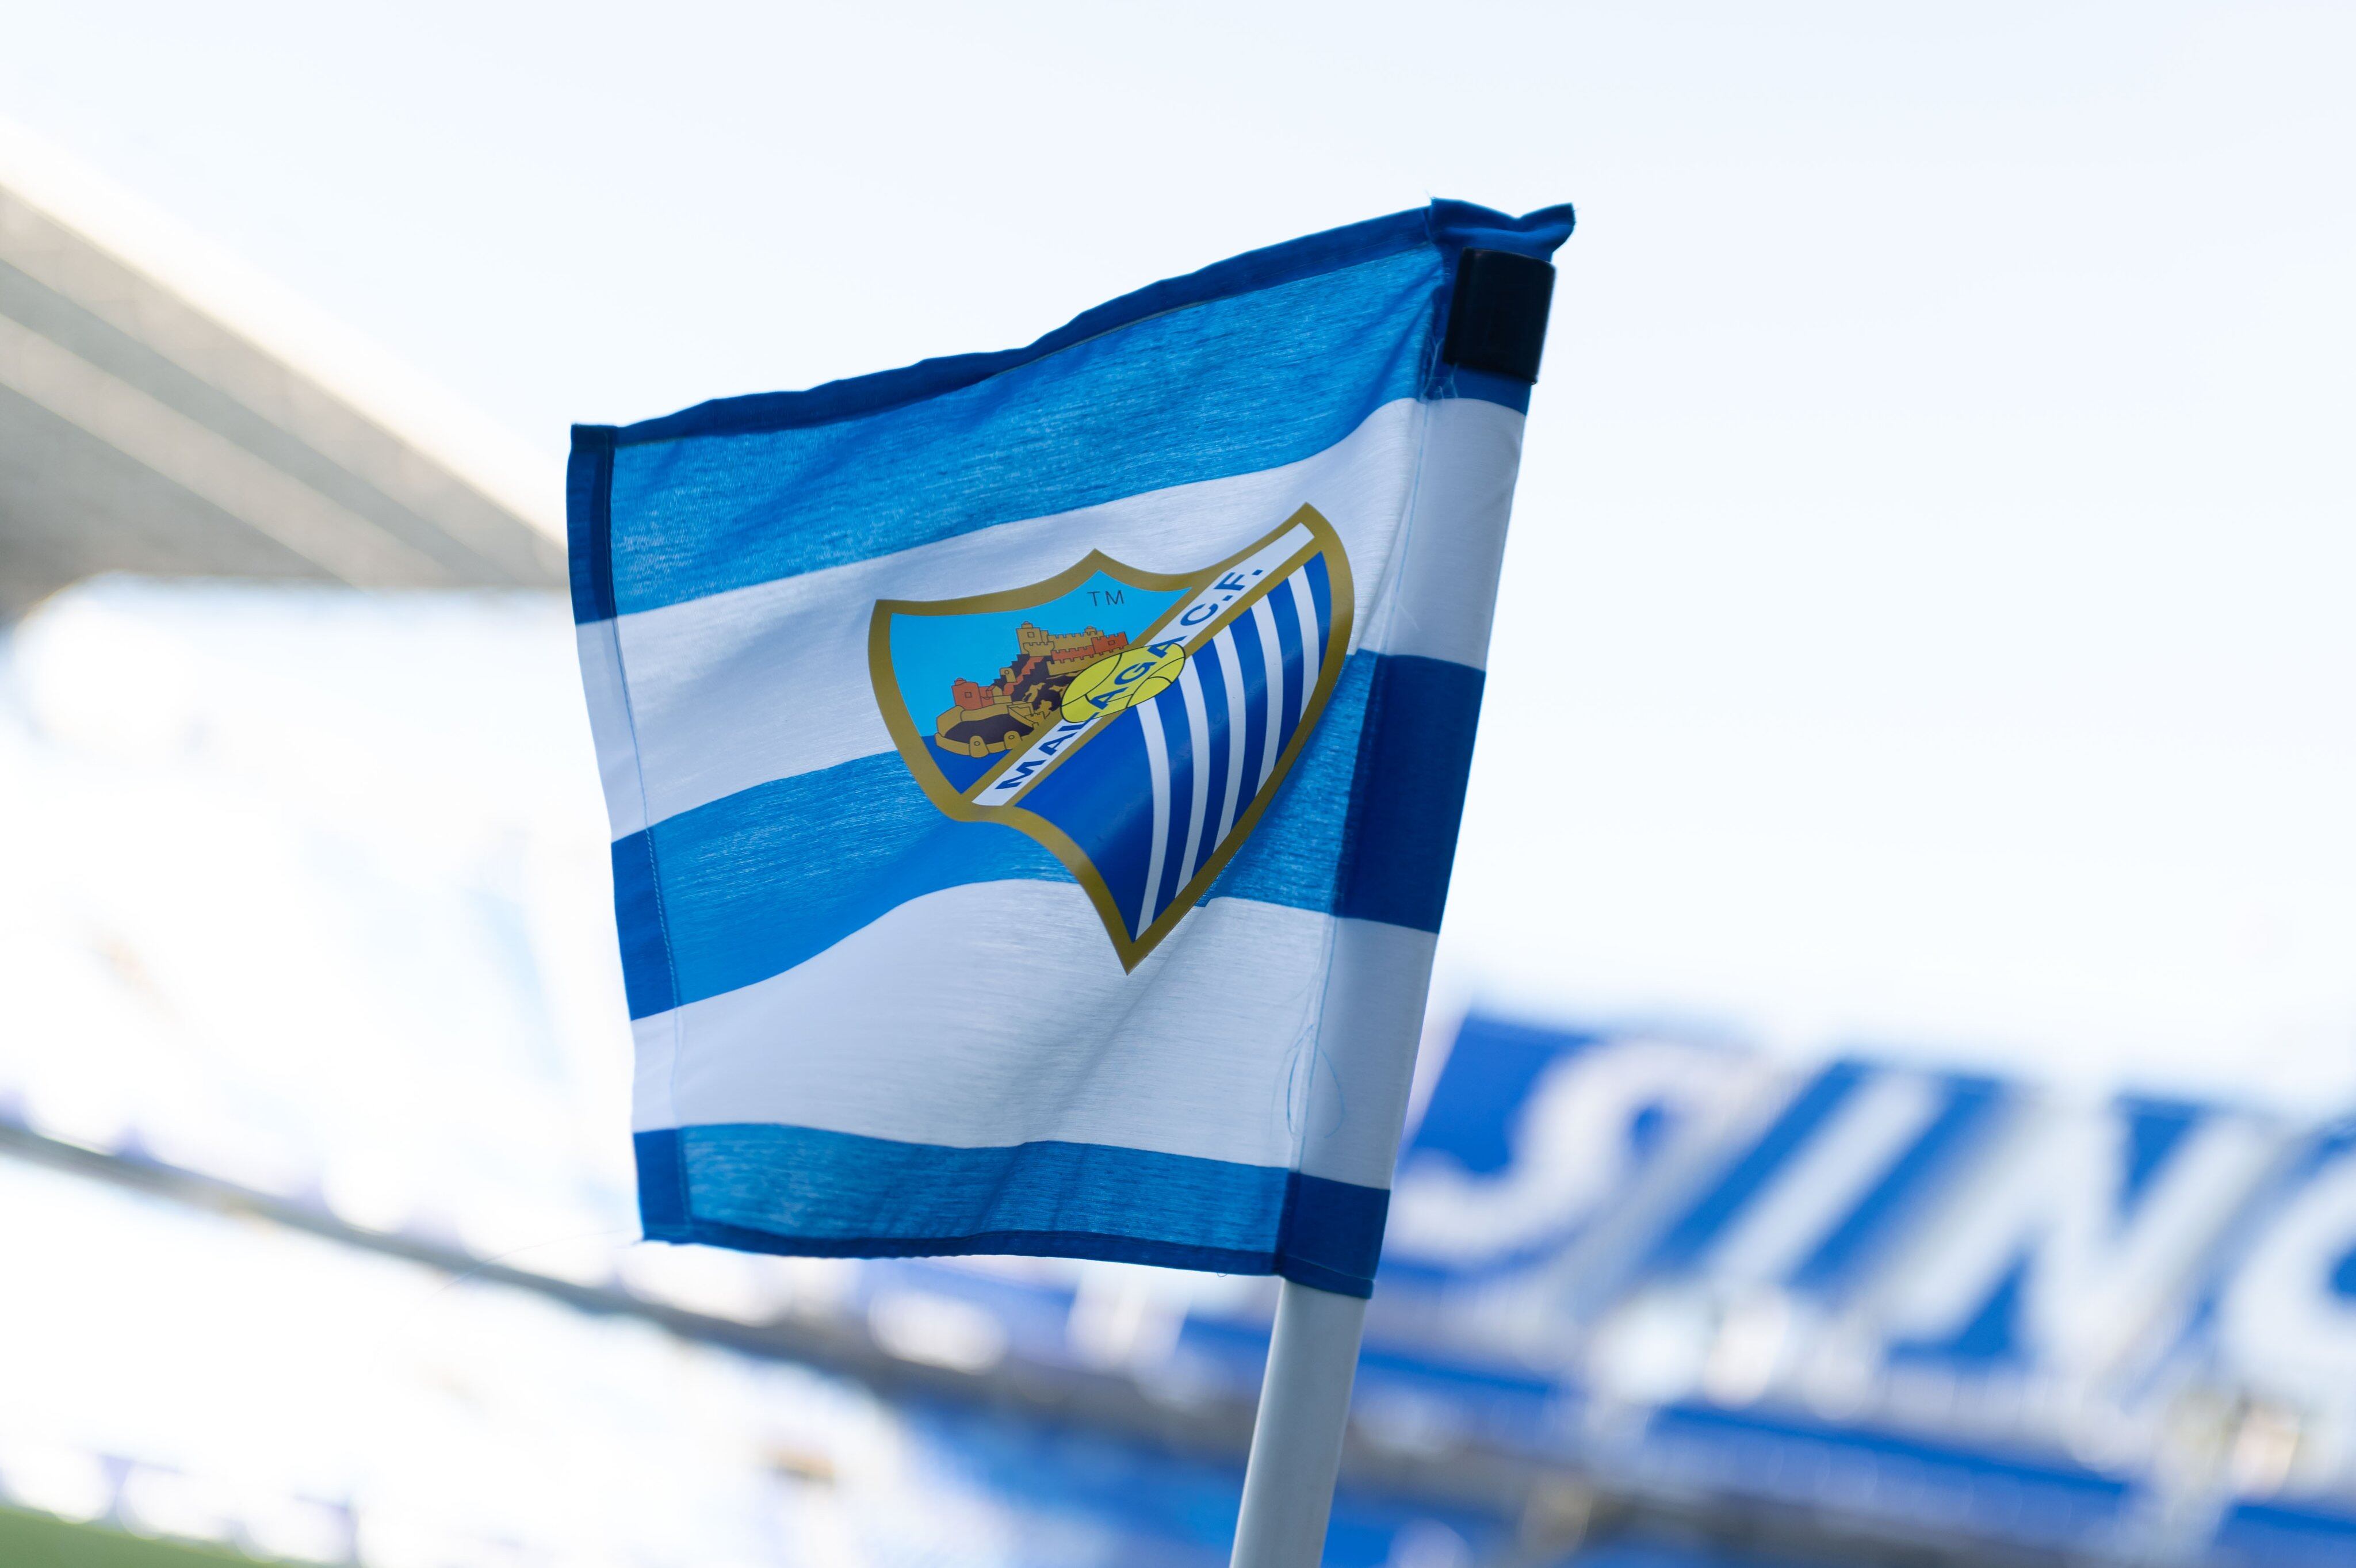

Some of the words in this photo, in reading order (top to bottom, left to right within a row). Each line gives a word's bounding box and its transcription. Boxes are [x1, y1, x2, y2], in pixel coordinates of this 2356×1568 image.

[1087, 590, 1124, 606] TM
[994, 636, 1187, 790] MALAGA
[1180, 569, 1264, 626] C.F.
